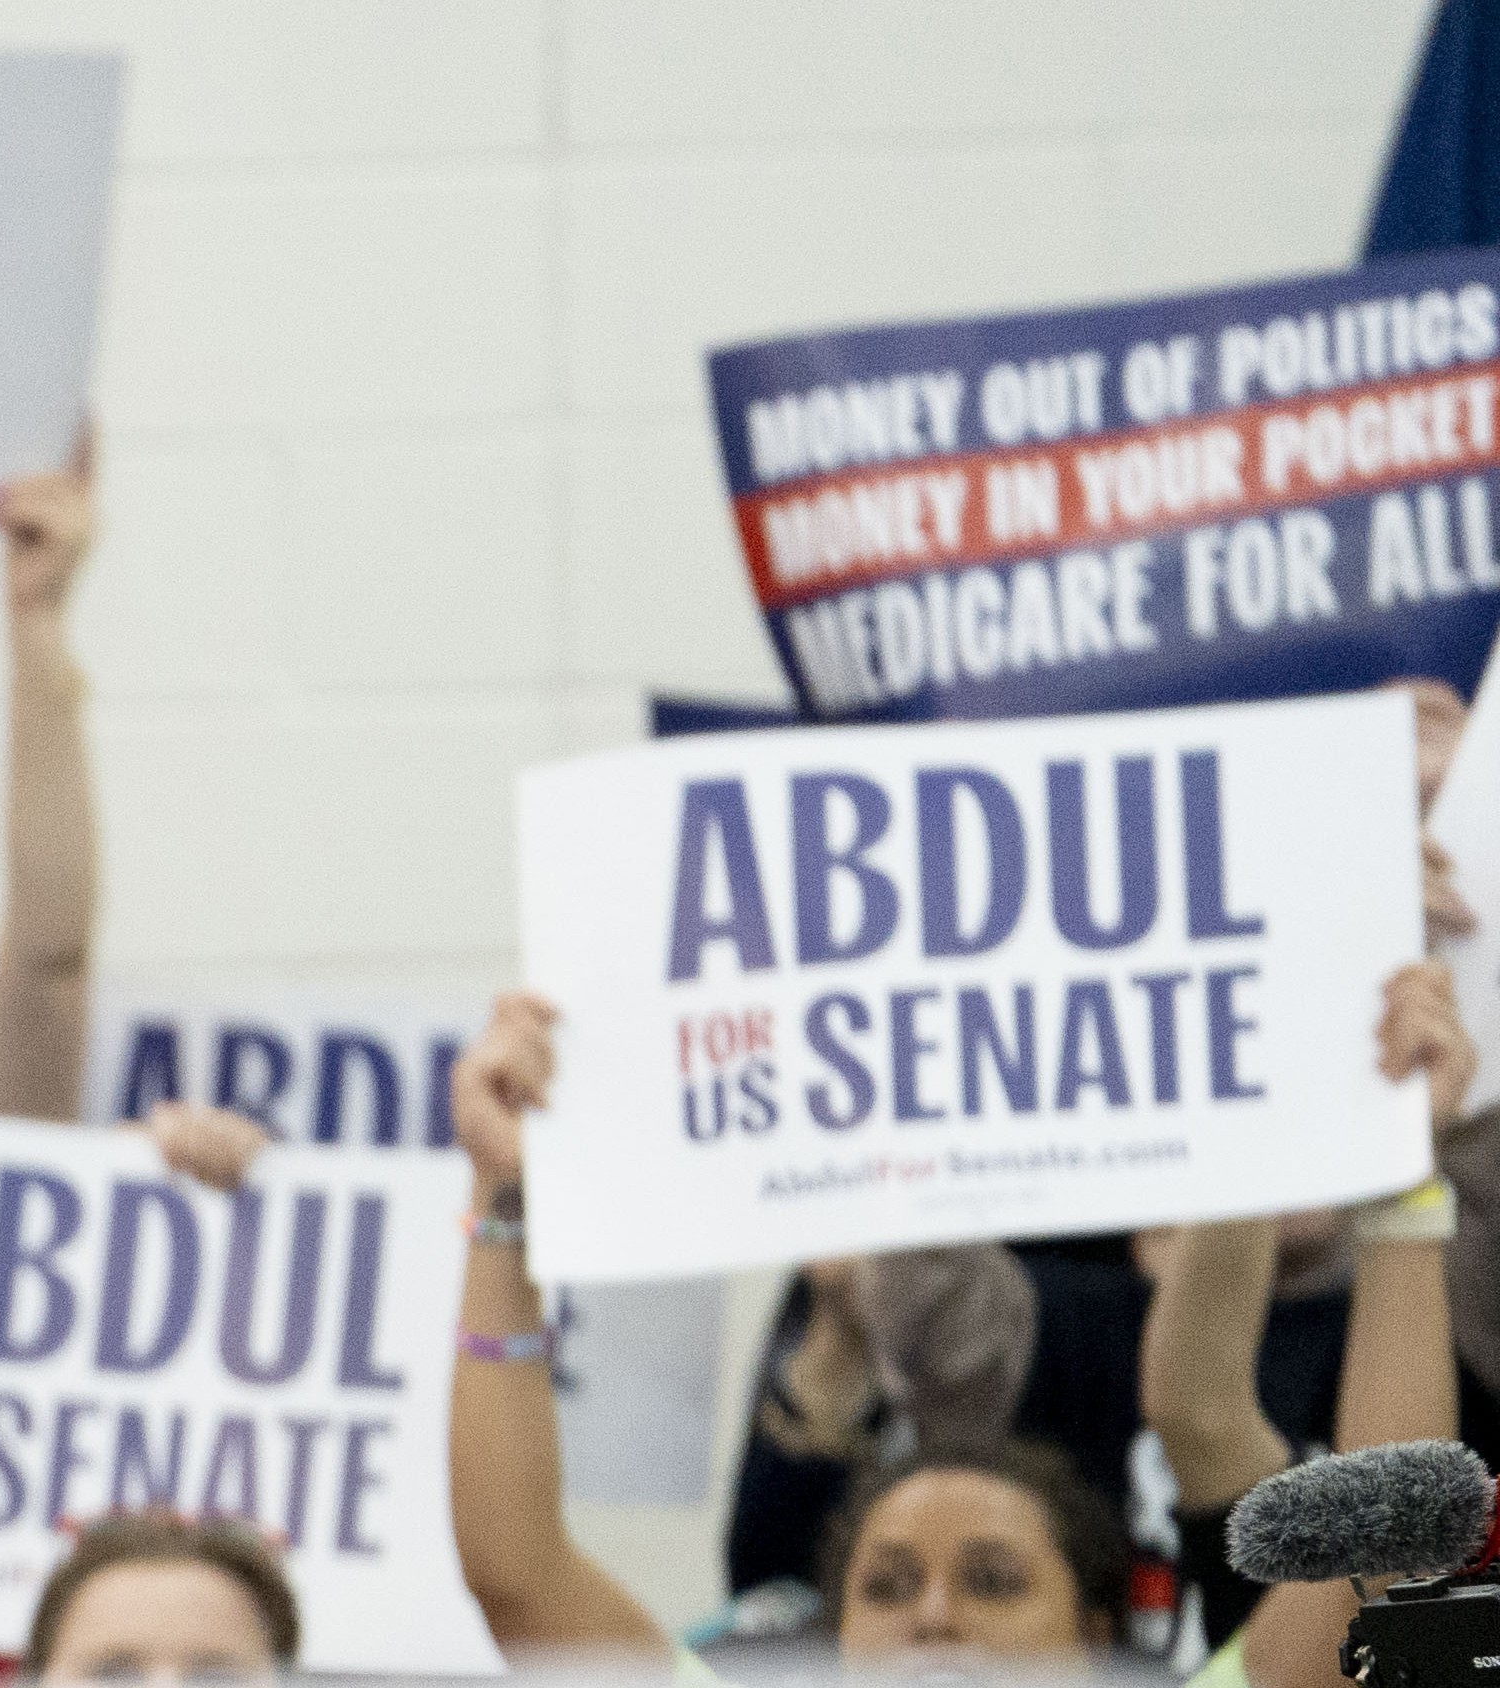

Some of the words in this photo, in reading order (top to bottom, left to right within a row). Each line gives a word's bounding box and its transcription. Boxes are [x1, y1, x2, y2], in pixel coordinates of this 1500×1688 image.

[746, 371, 965, 482] MONEY
[982, 351, 1107, 446] OUT
[1123, 335, 1202, 424] OF
[1220, 283, 1500, 400] POLITICS
[760, 471, 967, 588] MONEY
[985, 458, 1060, 543] IN
[1078, 426, 1243, 529] YOUR
[1261, 376, 1498, 492] POCKET
[786, 540, 1158, 712] MEDICARE
[1185, 509, 1339, 641] FOR
[1367, 479, 1500, 604] ALL
[665, 749, 1265, 984] ABDUL
[678, 1008, 776, 1078] FOR
[681, 1061, 779, 1142] US
[803, 963, 1267, 1132] SENATE
